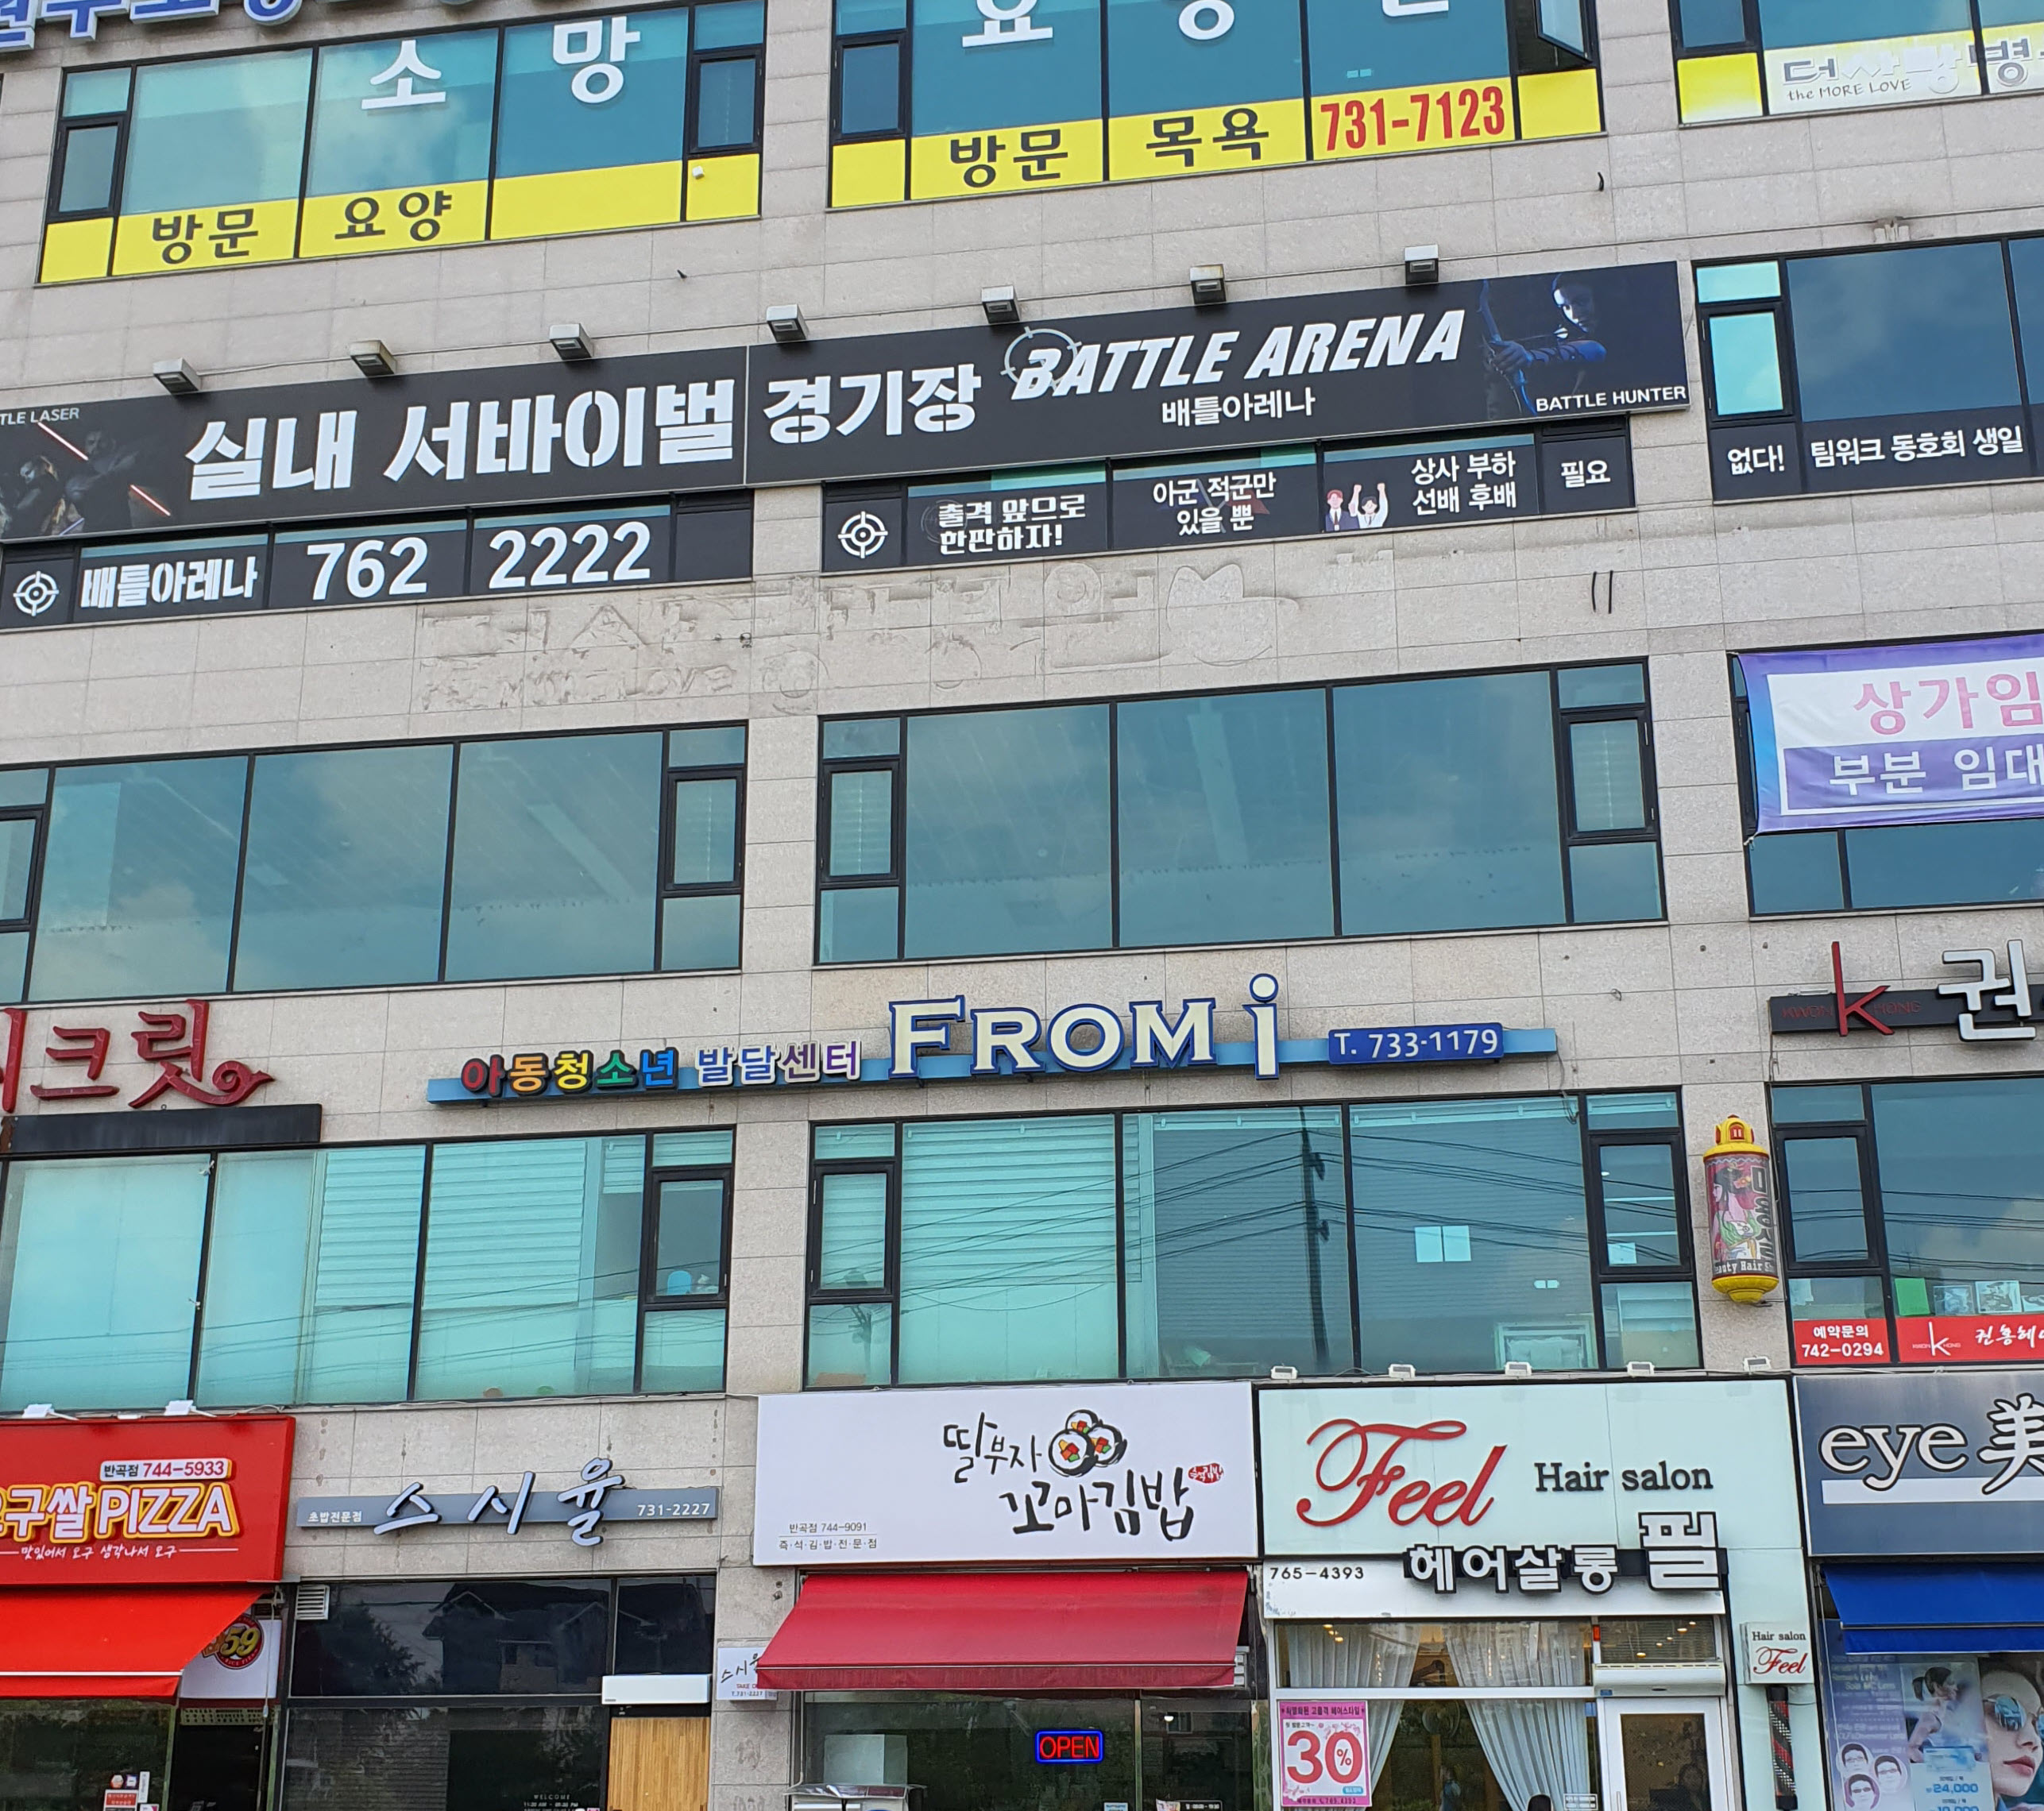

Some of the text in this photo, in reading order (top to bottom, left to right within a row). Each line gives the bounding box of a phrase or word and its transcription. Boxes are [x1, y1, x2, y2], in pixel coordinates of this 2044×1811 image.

[1787, 79, 1911, 101] the MORE LOVE
[950, 86, 1505, 188] 방문 목욕 731-7123
[152, 190, 452, 265] 방문 요양
[1010, 310, 1465, 400] BATTLE ARENA
[31, 407, 79, 423] LASER
[1161, 387, 1316, 427] 배틀아레나
[1536, 386, 1687, 413] BATTLE HUNTER
[185, 363, 982, 501] 실내 서바이벌 경기장
[1810, 425, 2023, 468] 팀워크 동호회 생일
[1411, 450, 1515, 485] 상사 부하
[1561, 459, 1611, 488] 필요
[1727, 445, 1784, 476] 없다!
[1153, 472, 1276, 508] 아군 적군만
[1413, 481, 1517, 516] 선배 후배
[939, 501, 992, 527] 출격
[1177, 504, 1254, 536] 있을 뿐
[940, 523, 1062, 554] 한판하자!
[307, 521, 651, 601] 762 2222
[80, 556, 258, 608] 배틀아레나
[1853, 671, 2044, 735] 상가임
[1829, 743, 2044, 796] 부분 임대
[888, 995, 1217, 1079] FROM
[1333, 1028, 1498, 1059] T. 733-1179
[461, 1039, 861, 1097] 아동청소년 발달센터
[1714, 1261, 1737, 1275] eauty
[1741, 1261, 1763, 1272] Hair
[1813, 1325, 1869, 1339] 예약문의
[1802, 1342, 1884, 1357] 742-0294
[943, 1412, 1041, 1483] 딸부자
[104, 1461, 224, 1478] 반곡점 744-5933
[1296, 1418, 1508, 1527] Feel
[1534, 1461, 1714, 1492] Hair salon
[0, 1485, 232, 1539] 구쌀 PIZZA
[307, 1511, 362, 1523] 초밥전문점
[637, 1502, 710, 1517] 731-2227
[999, 1467, 1194, 1542] 꼬마김밥
[789, 1522, 867, 1534] 반곡점 744-9091
[21, 1543, 177, 1560] 맛있어서 오구 생각나서 오구
[1408, 1511, 1721, 1595] 헤어살롱 필
[1269, 1566, 1364, 1580] 765-4393
[1752, 1631, 1806, 1641] Hair salon
[1752, 1646, 1808, 1674] Feel
[1040, 1736, 1100, 1759] OPEN
[1287, 1730, 1363, 1784] 30%
